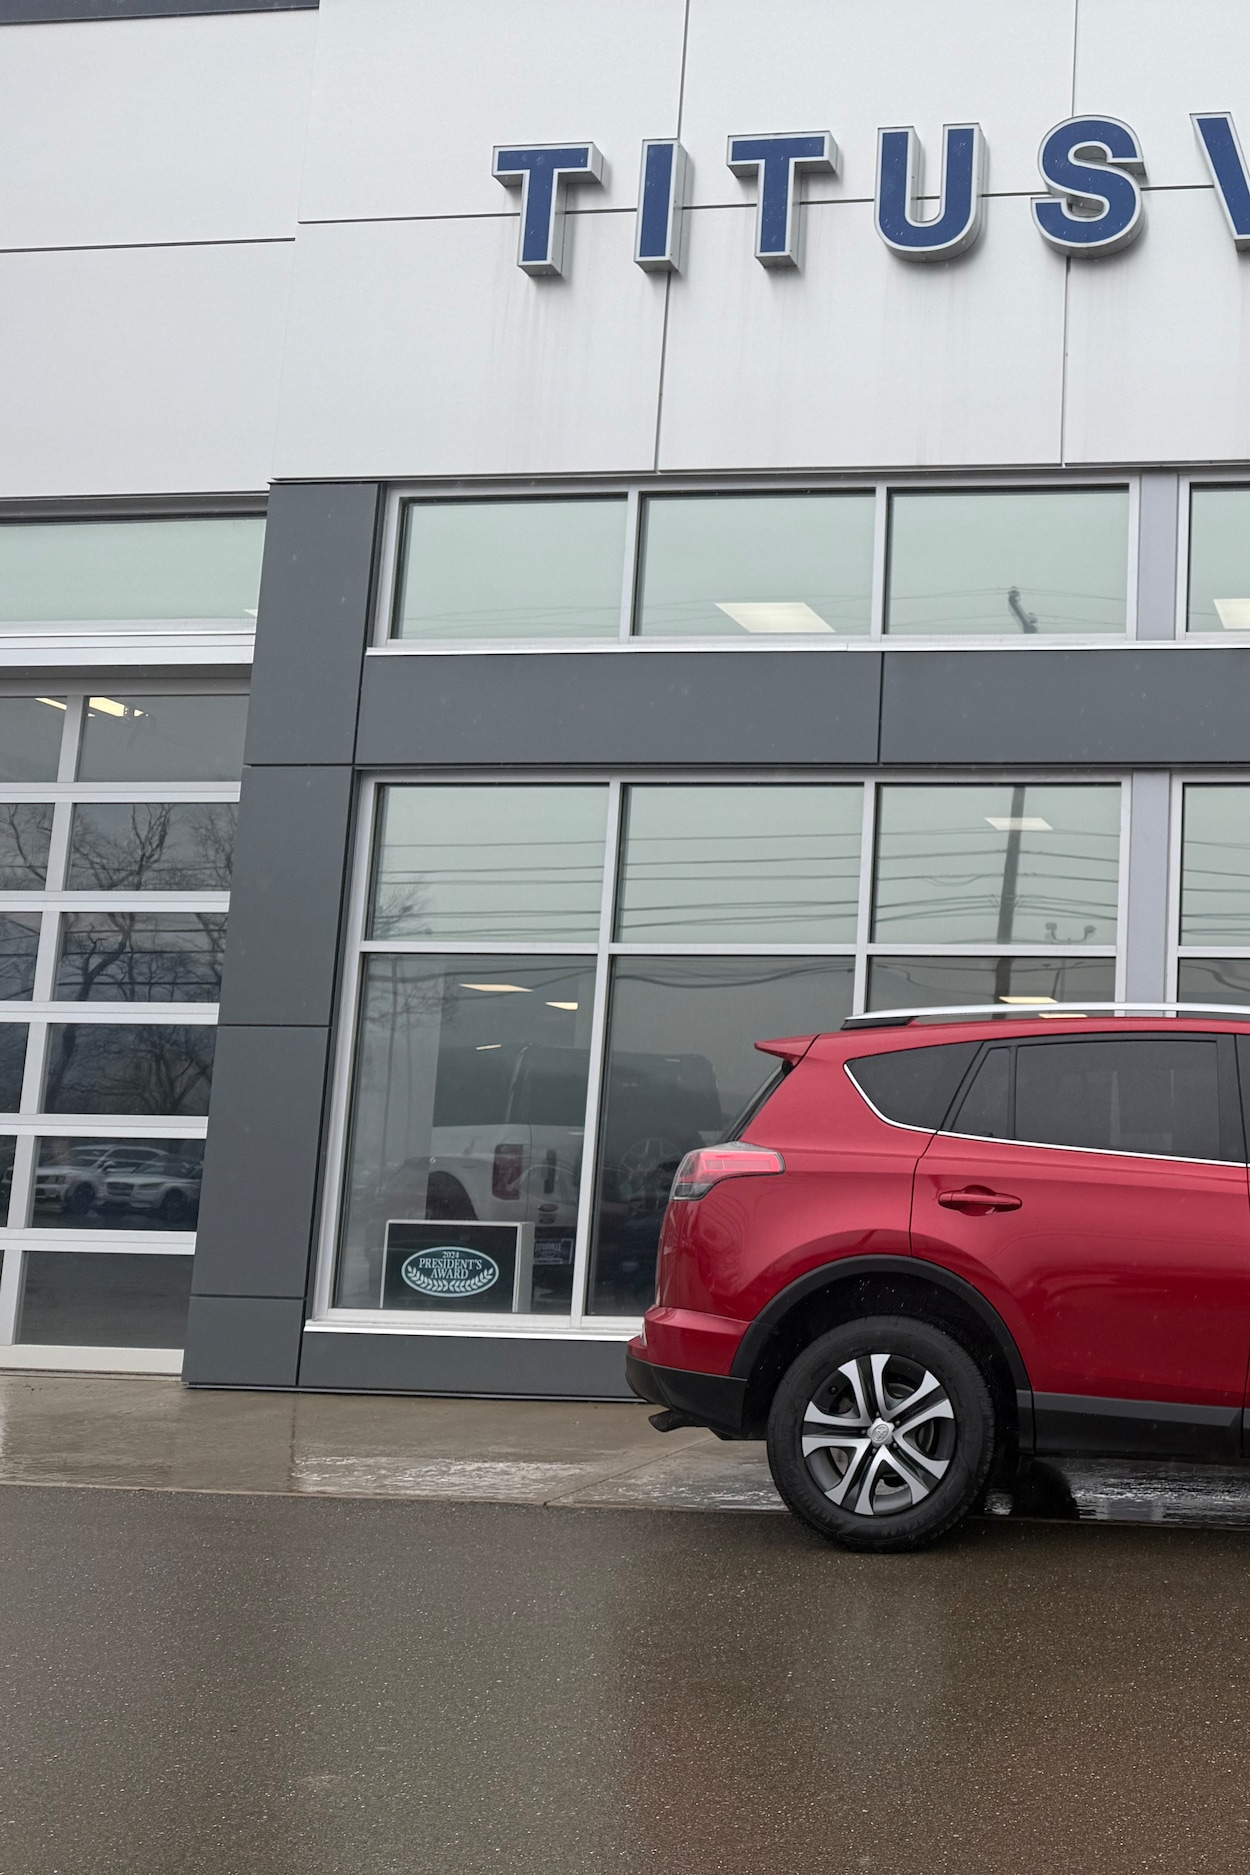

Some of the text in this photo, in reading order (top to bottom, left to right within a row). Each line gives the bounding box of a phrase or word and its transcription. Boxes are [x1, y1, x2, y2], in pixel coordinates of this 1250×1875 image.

[442, 1251, 460, 1259] 2024
[419, 1258, 482, 1270] PRESIDENT'S
[431, 1268, 469, 1279] AWARD
